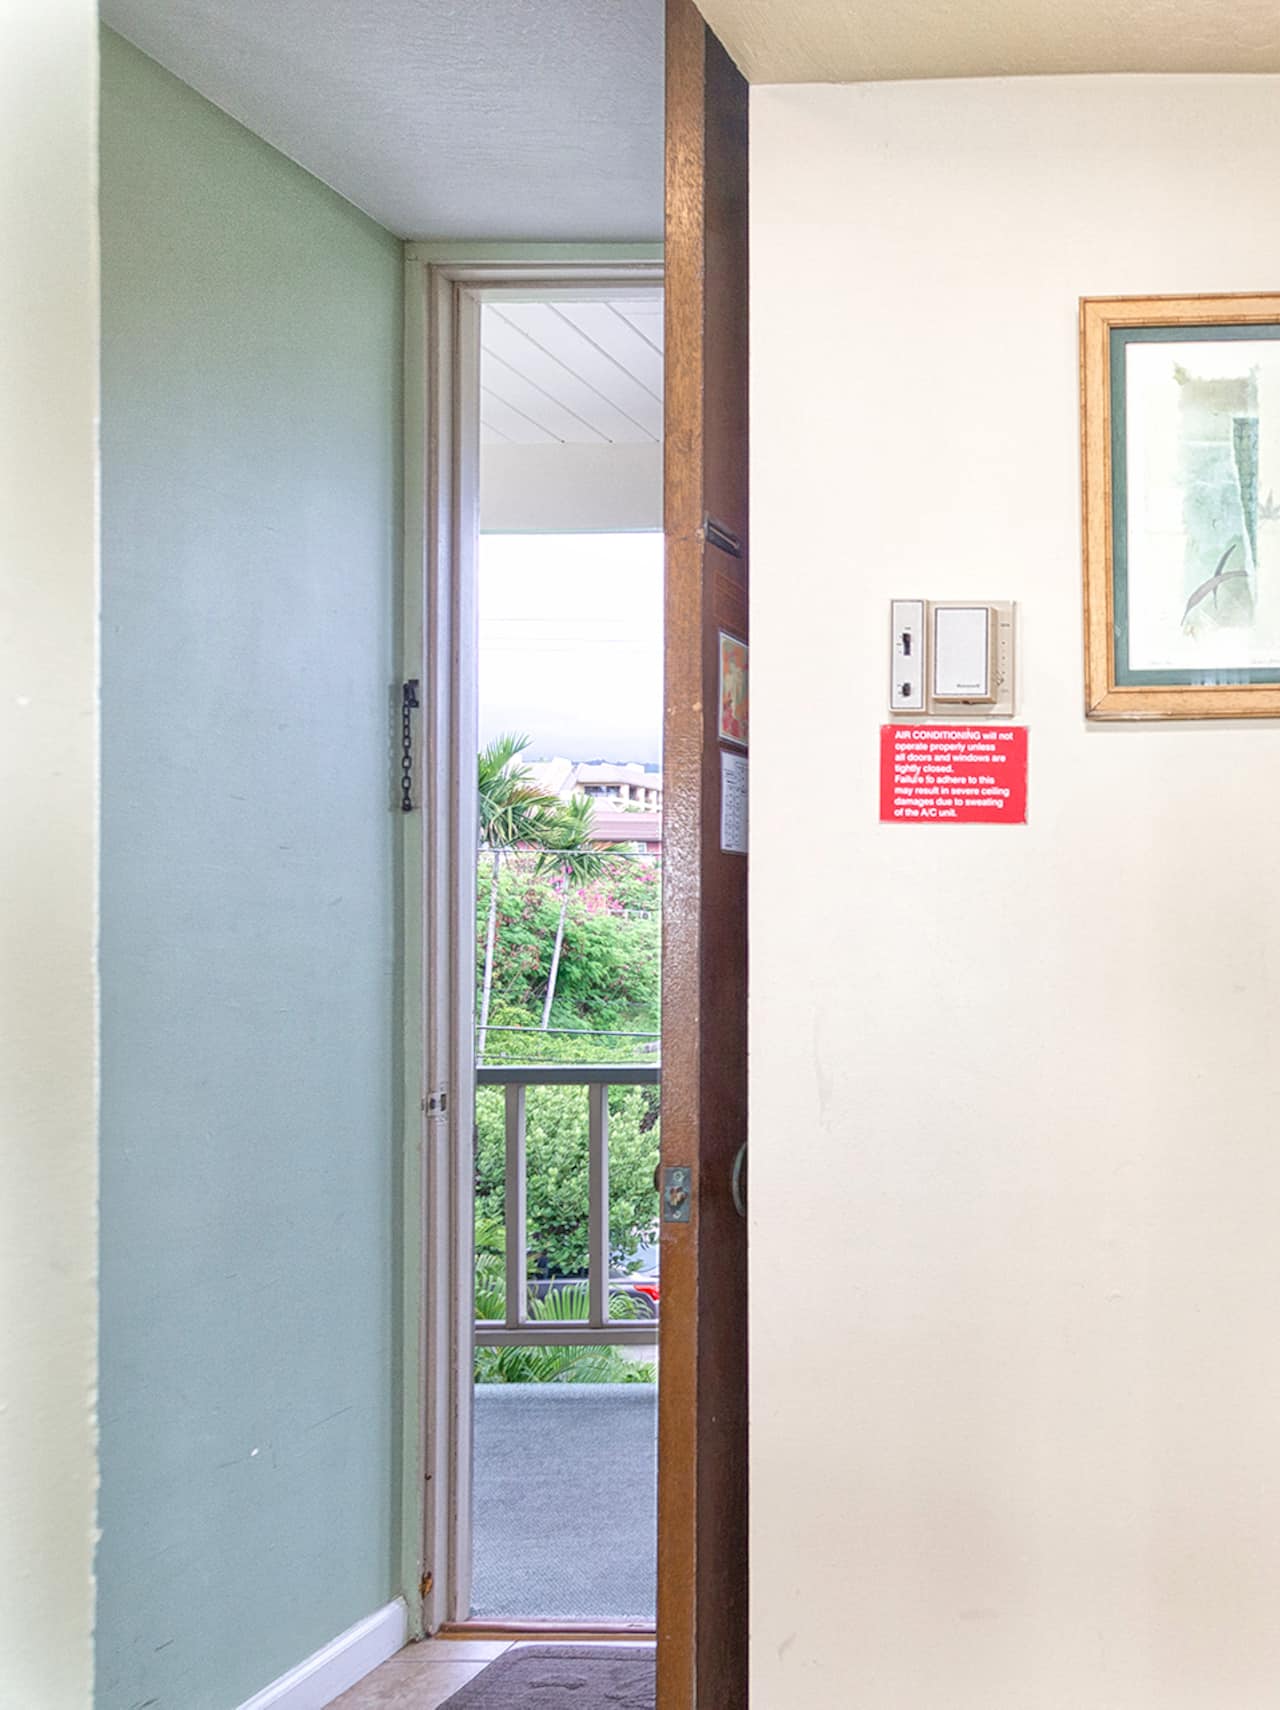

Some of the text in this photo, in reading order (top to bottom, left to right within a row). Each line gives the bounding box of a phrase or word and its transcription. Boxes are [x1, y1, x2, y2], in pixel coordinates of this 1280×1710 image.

[895, 730, 1013, 740] AIR CONDITIONING will not
[895, 743, 996, 752] operate properly unless
[907, 754, 932, 762] doors
[934, 754, 950, 762] and
[952, 754, 990, 762] windows
[895, 764, 954, 774] tightly closed.
[894, 775, 995, 784] Failure to adhere to this
[894, 788, 914, 796] may
[941, 787, 950, 795] in
[981, 787, 1010, 796] ceiling
[894, 798, 1003, 808] damages due to sweating
[894, 808, 903, 816] of
[904, 808, 919, 816] the
